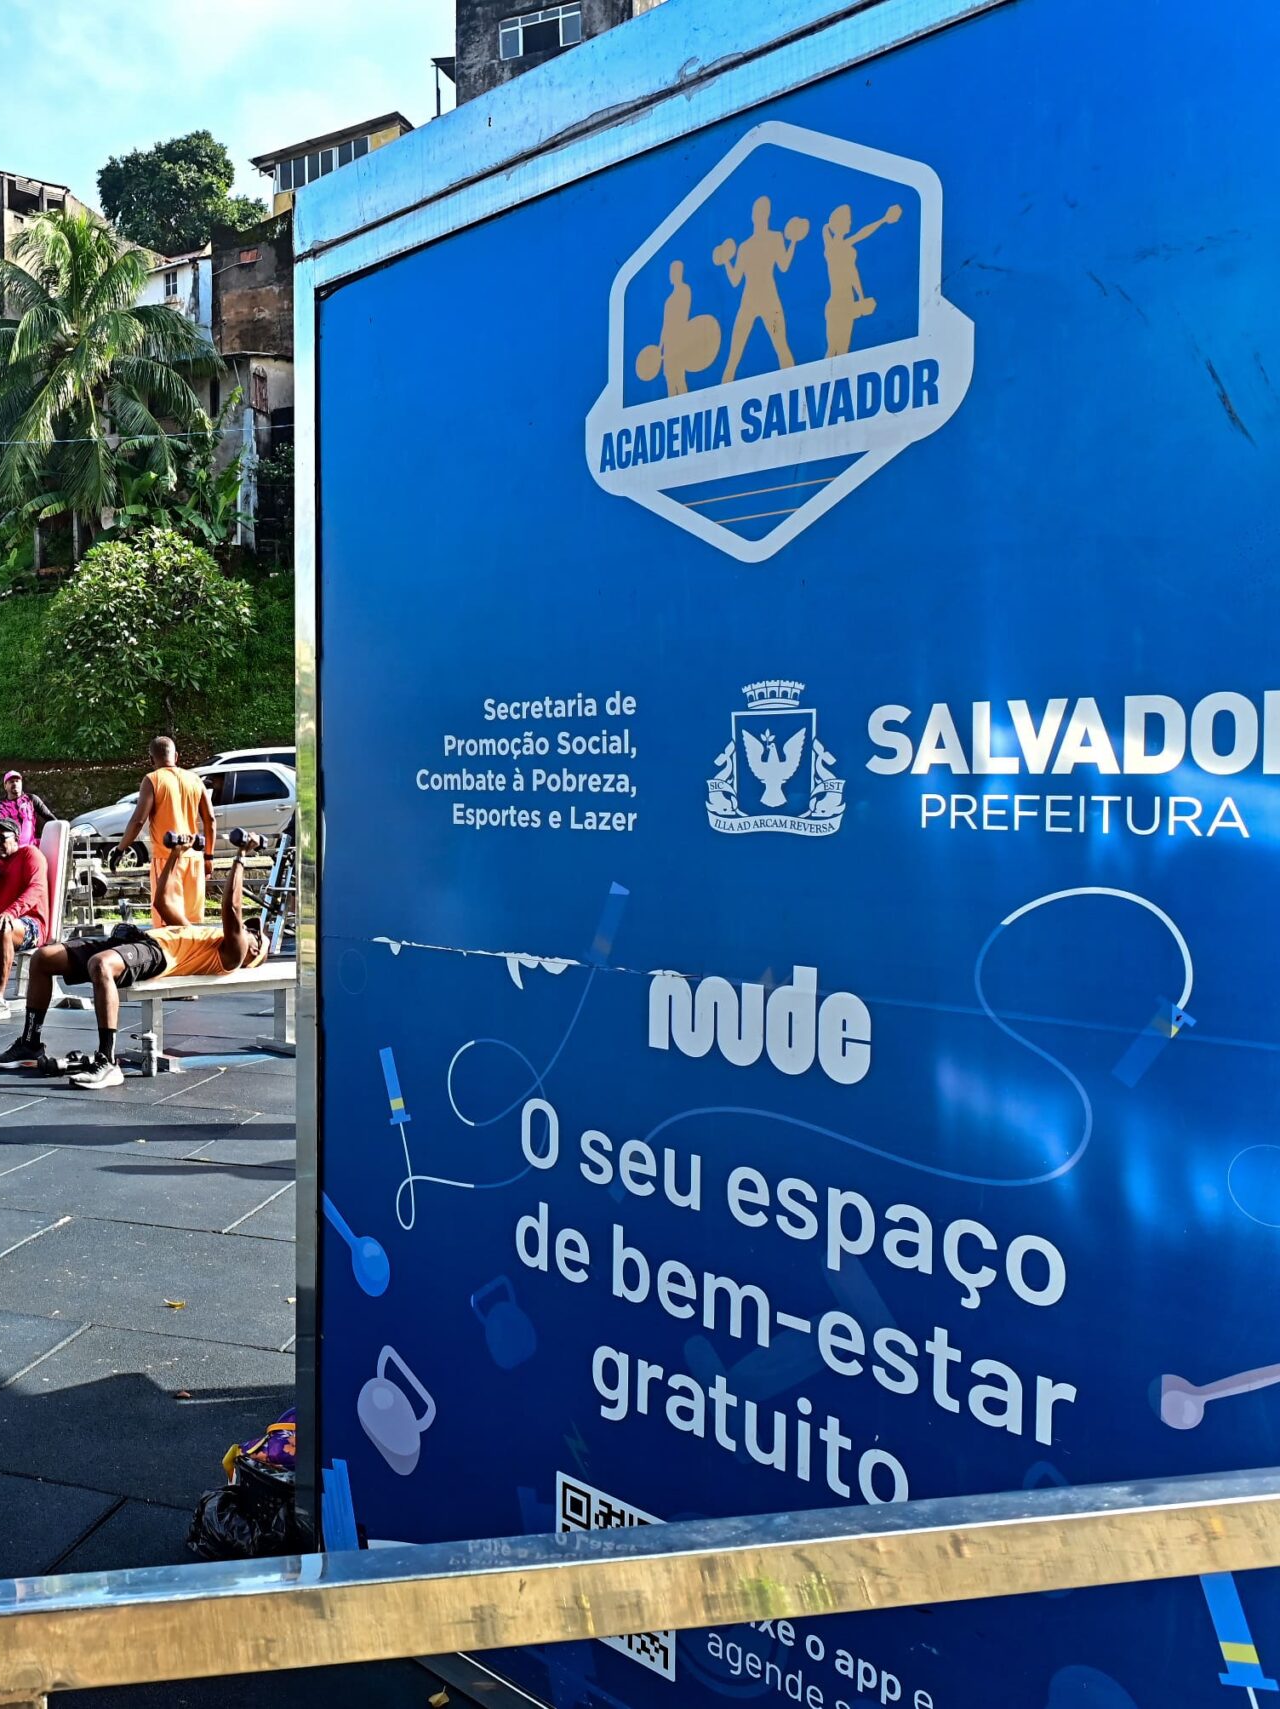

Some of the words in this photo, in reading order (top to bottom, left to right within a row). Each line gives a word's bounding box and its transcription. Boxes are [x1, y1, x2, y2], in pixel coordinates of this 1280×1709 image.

[600, 405, 732, 473] ACADEMIA
[741, 358, 939, 443] SALVADOR
[483, 692, 597, 720] Secretaria
[605, 690, 637, 716] de
[865, 690, 1280, 776] SALVADO
[443, 731, 550, 760] Promoção
[557, 728, 637, 759] Social,
[416, 767, 507, 792] Combate
[512, 767, 524, 792] à
[532, 767, 637, 798] Pobreza,
[452, 802, 541, 830] Esportes
[548, 809, 562, 829] e
[570, 806, 638, 832] Lazer
[920, 793, 1251, 839] PREFEITURA
[714, 818, 735, 831] ILLA
[736, 820, 751, 832] AD
[752, 818, 788, 829] ARCAM
[790, 820, 836, 834] REVERSA
[520, 1098, 559, 1170] O
[580, 1129, 701, 1212] seu
[727, 1166, 1067, 1309] espaço
[516, 1202, 589, 1283] de
[612, 1224, 1077, 1446] bem-estar
[592, 1344, 909, 1505] gratuito
[707, 1632, 824, 1709] agende
[805, 1634, 825, 1661] o
[834, 1649, 902, 1704] app
[913, 1689, 933, 1709] e
